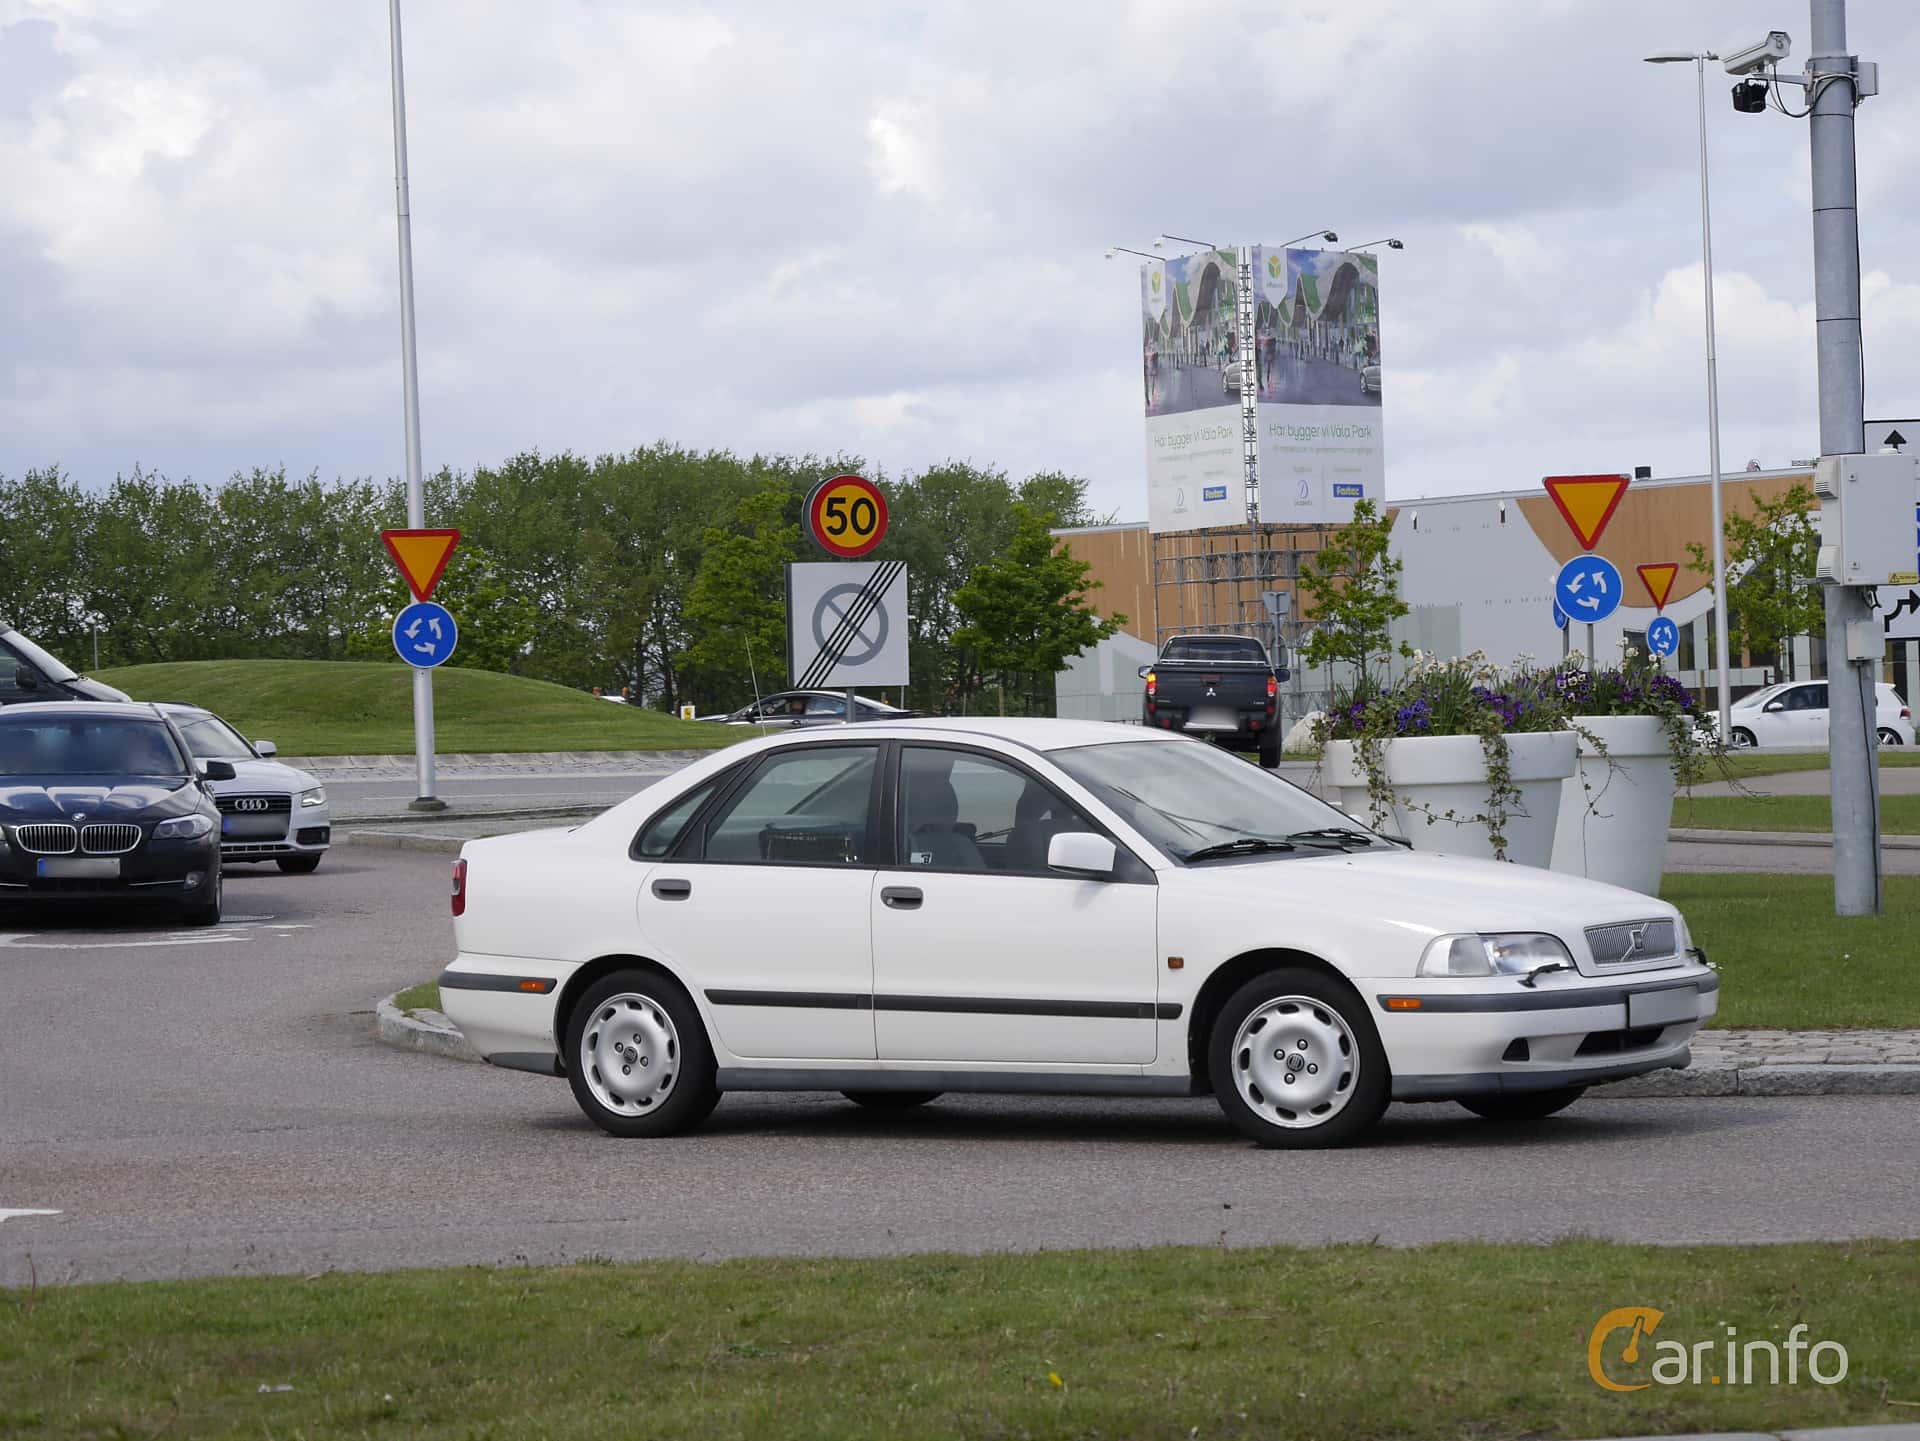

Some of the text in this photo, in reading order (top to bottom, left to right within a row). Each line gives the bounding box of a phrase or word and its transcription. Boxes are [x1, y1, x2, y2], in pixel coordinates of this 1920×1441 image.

[1168, 431, 1192, 449] bygger
[1217, 424, 1233, 439] Park
[1287, 423, 1320, 441] bygger
[1321, 424, 1329, 437] vi
[1351, 424, 1371, 438] Park
[826, 497, 876, 536] 50
